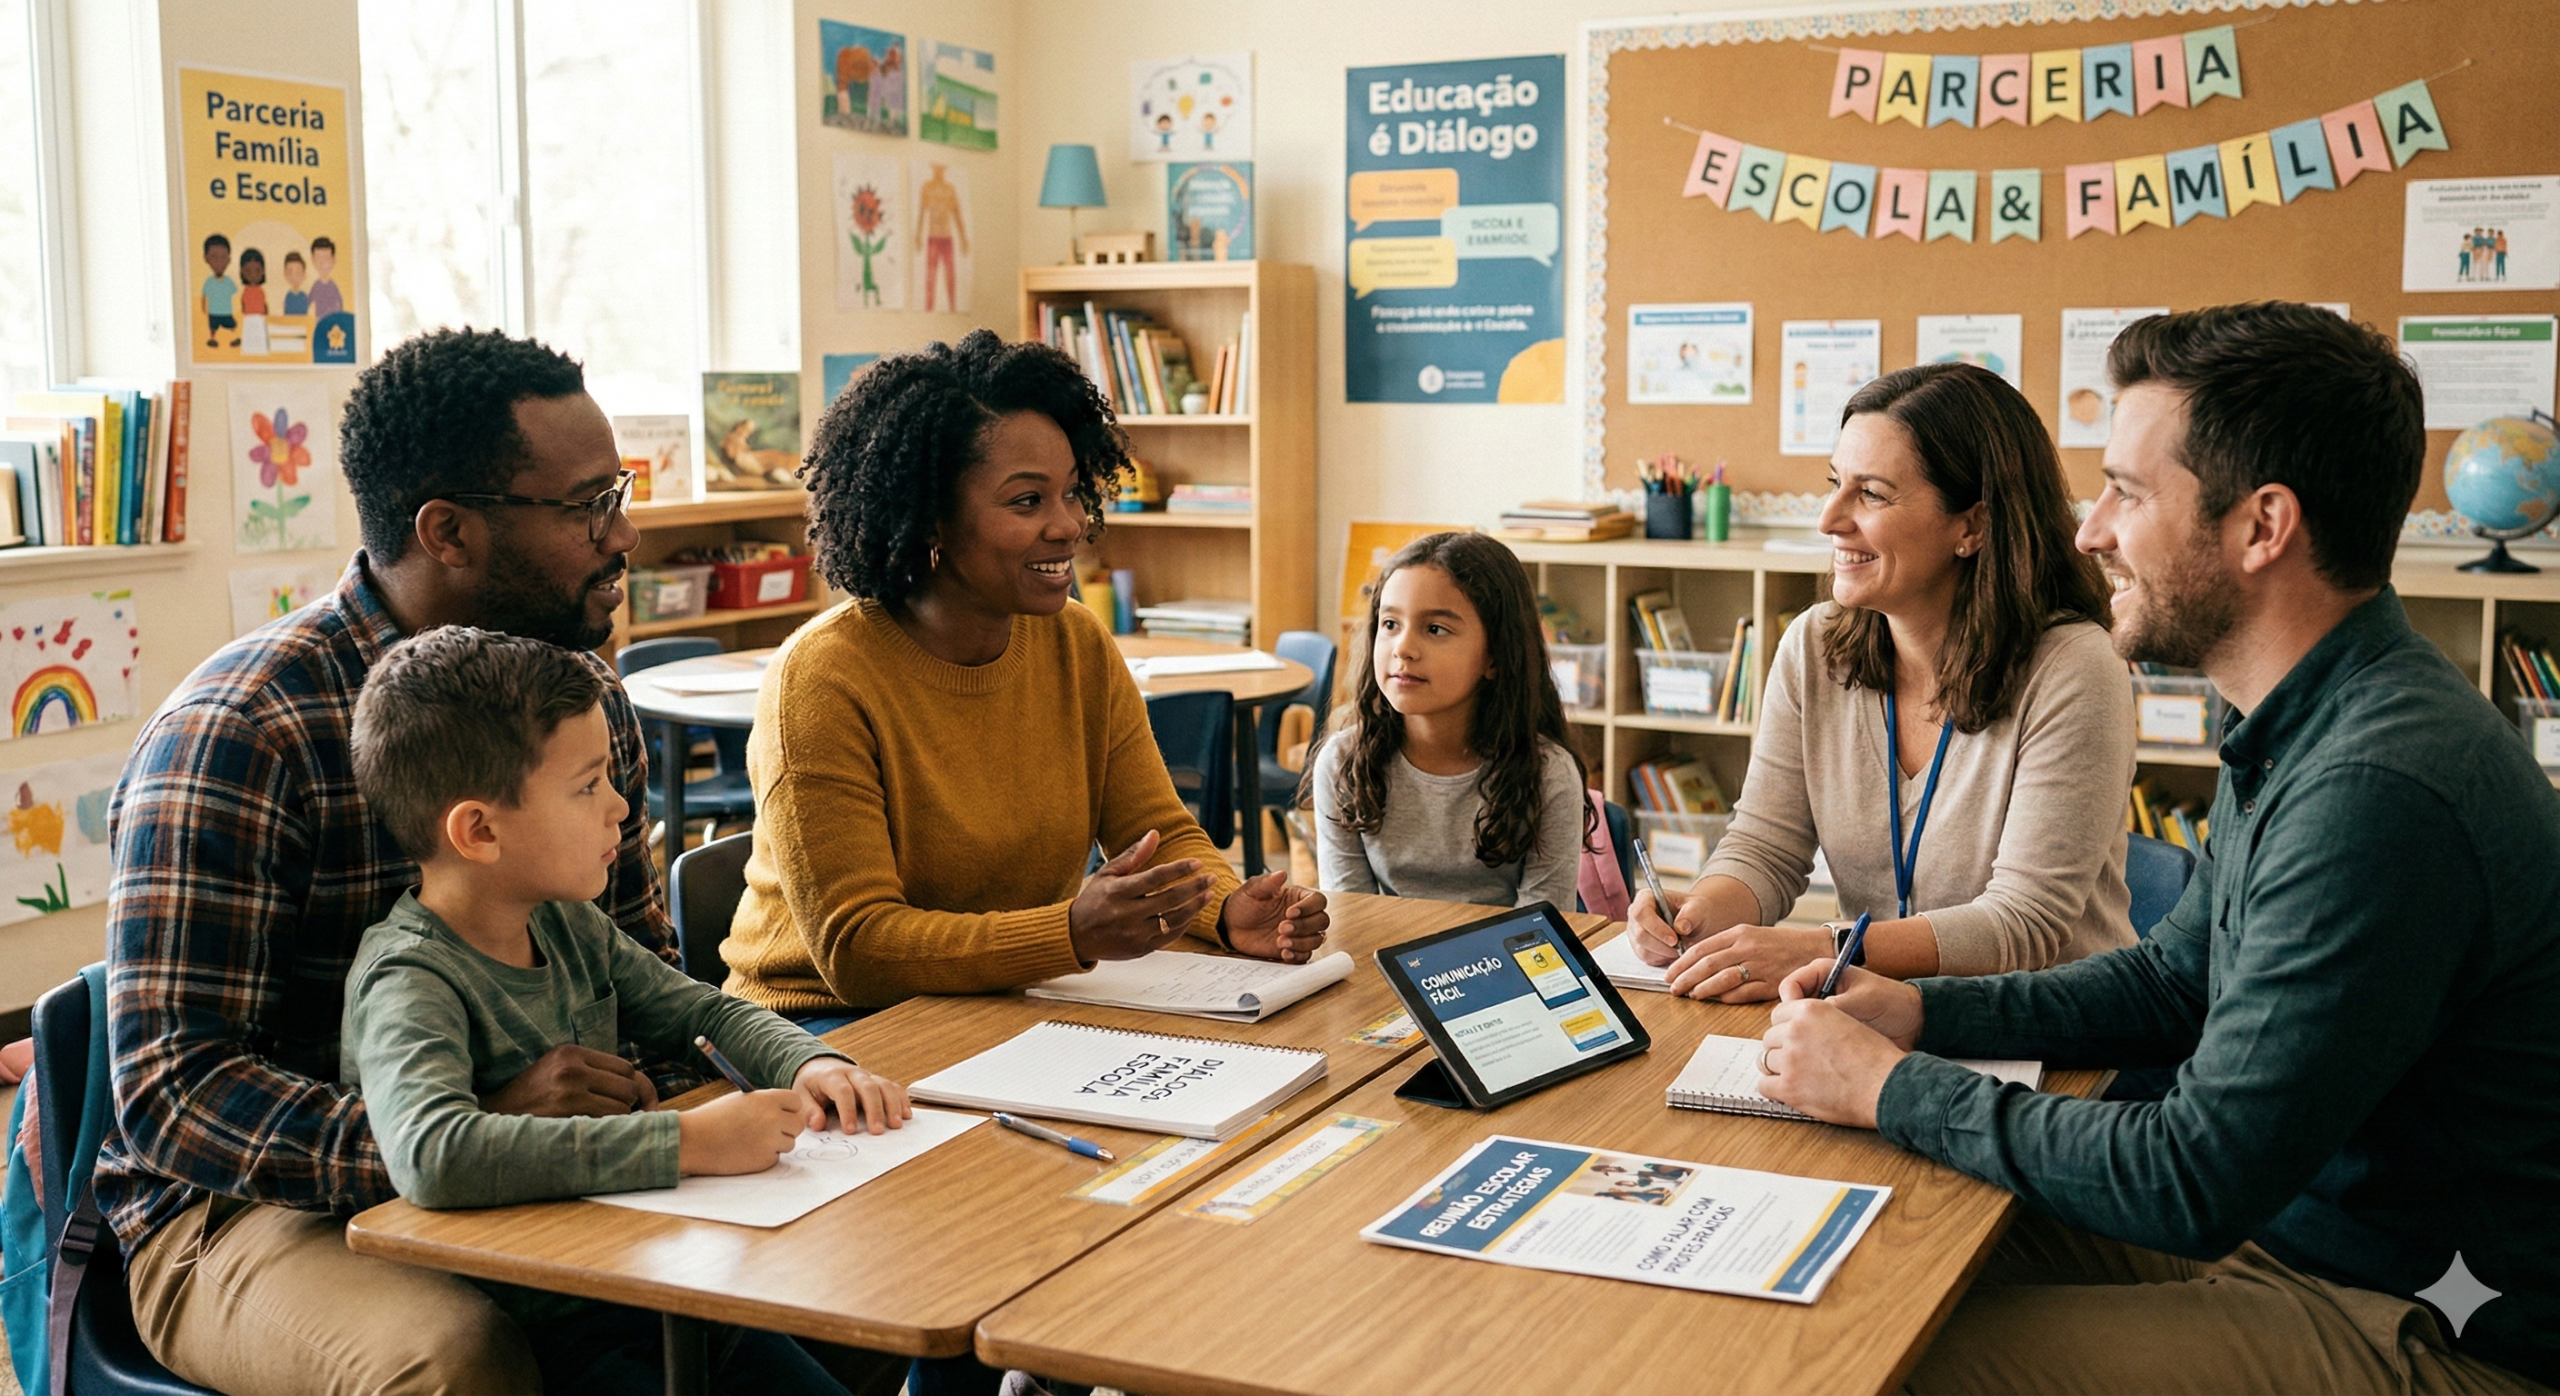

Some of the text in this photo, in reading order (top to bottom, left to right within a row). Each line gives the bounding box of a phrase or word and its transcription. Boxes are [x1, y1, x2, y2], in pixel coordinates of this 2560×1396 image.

[1368, 74, 1540, 117] Educação
[1844, 44, 2231, 107] PARCERIA
[206, 91, 325, 130] Parceria
[215, 131, 320, 168] Família
[1368, 117, 1539, 160] é Diálogo
[1701, 101, 2434, 222] ESCOLA & FAMÍLIA
[209, 172, 327, 206] e Escola
[1421, 957, 1503, 991] COMUNICAÇÃO
[1073, 1052, 1161, 1094] ESCOLA
[1419, 1194, 1485, 1238] REUNIÃO
[1474, 1151, 1539, 1196] ESCOLAR
[1636, 1196, 1717, 1271] COMO FALAR COM
